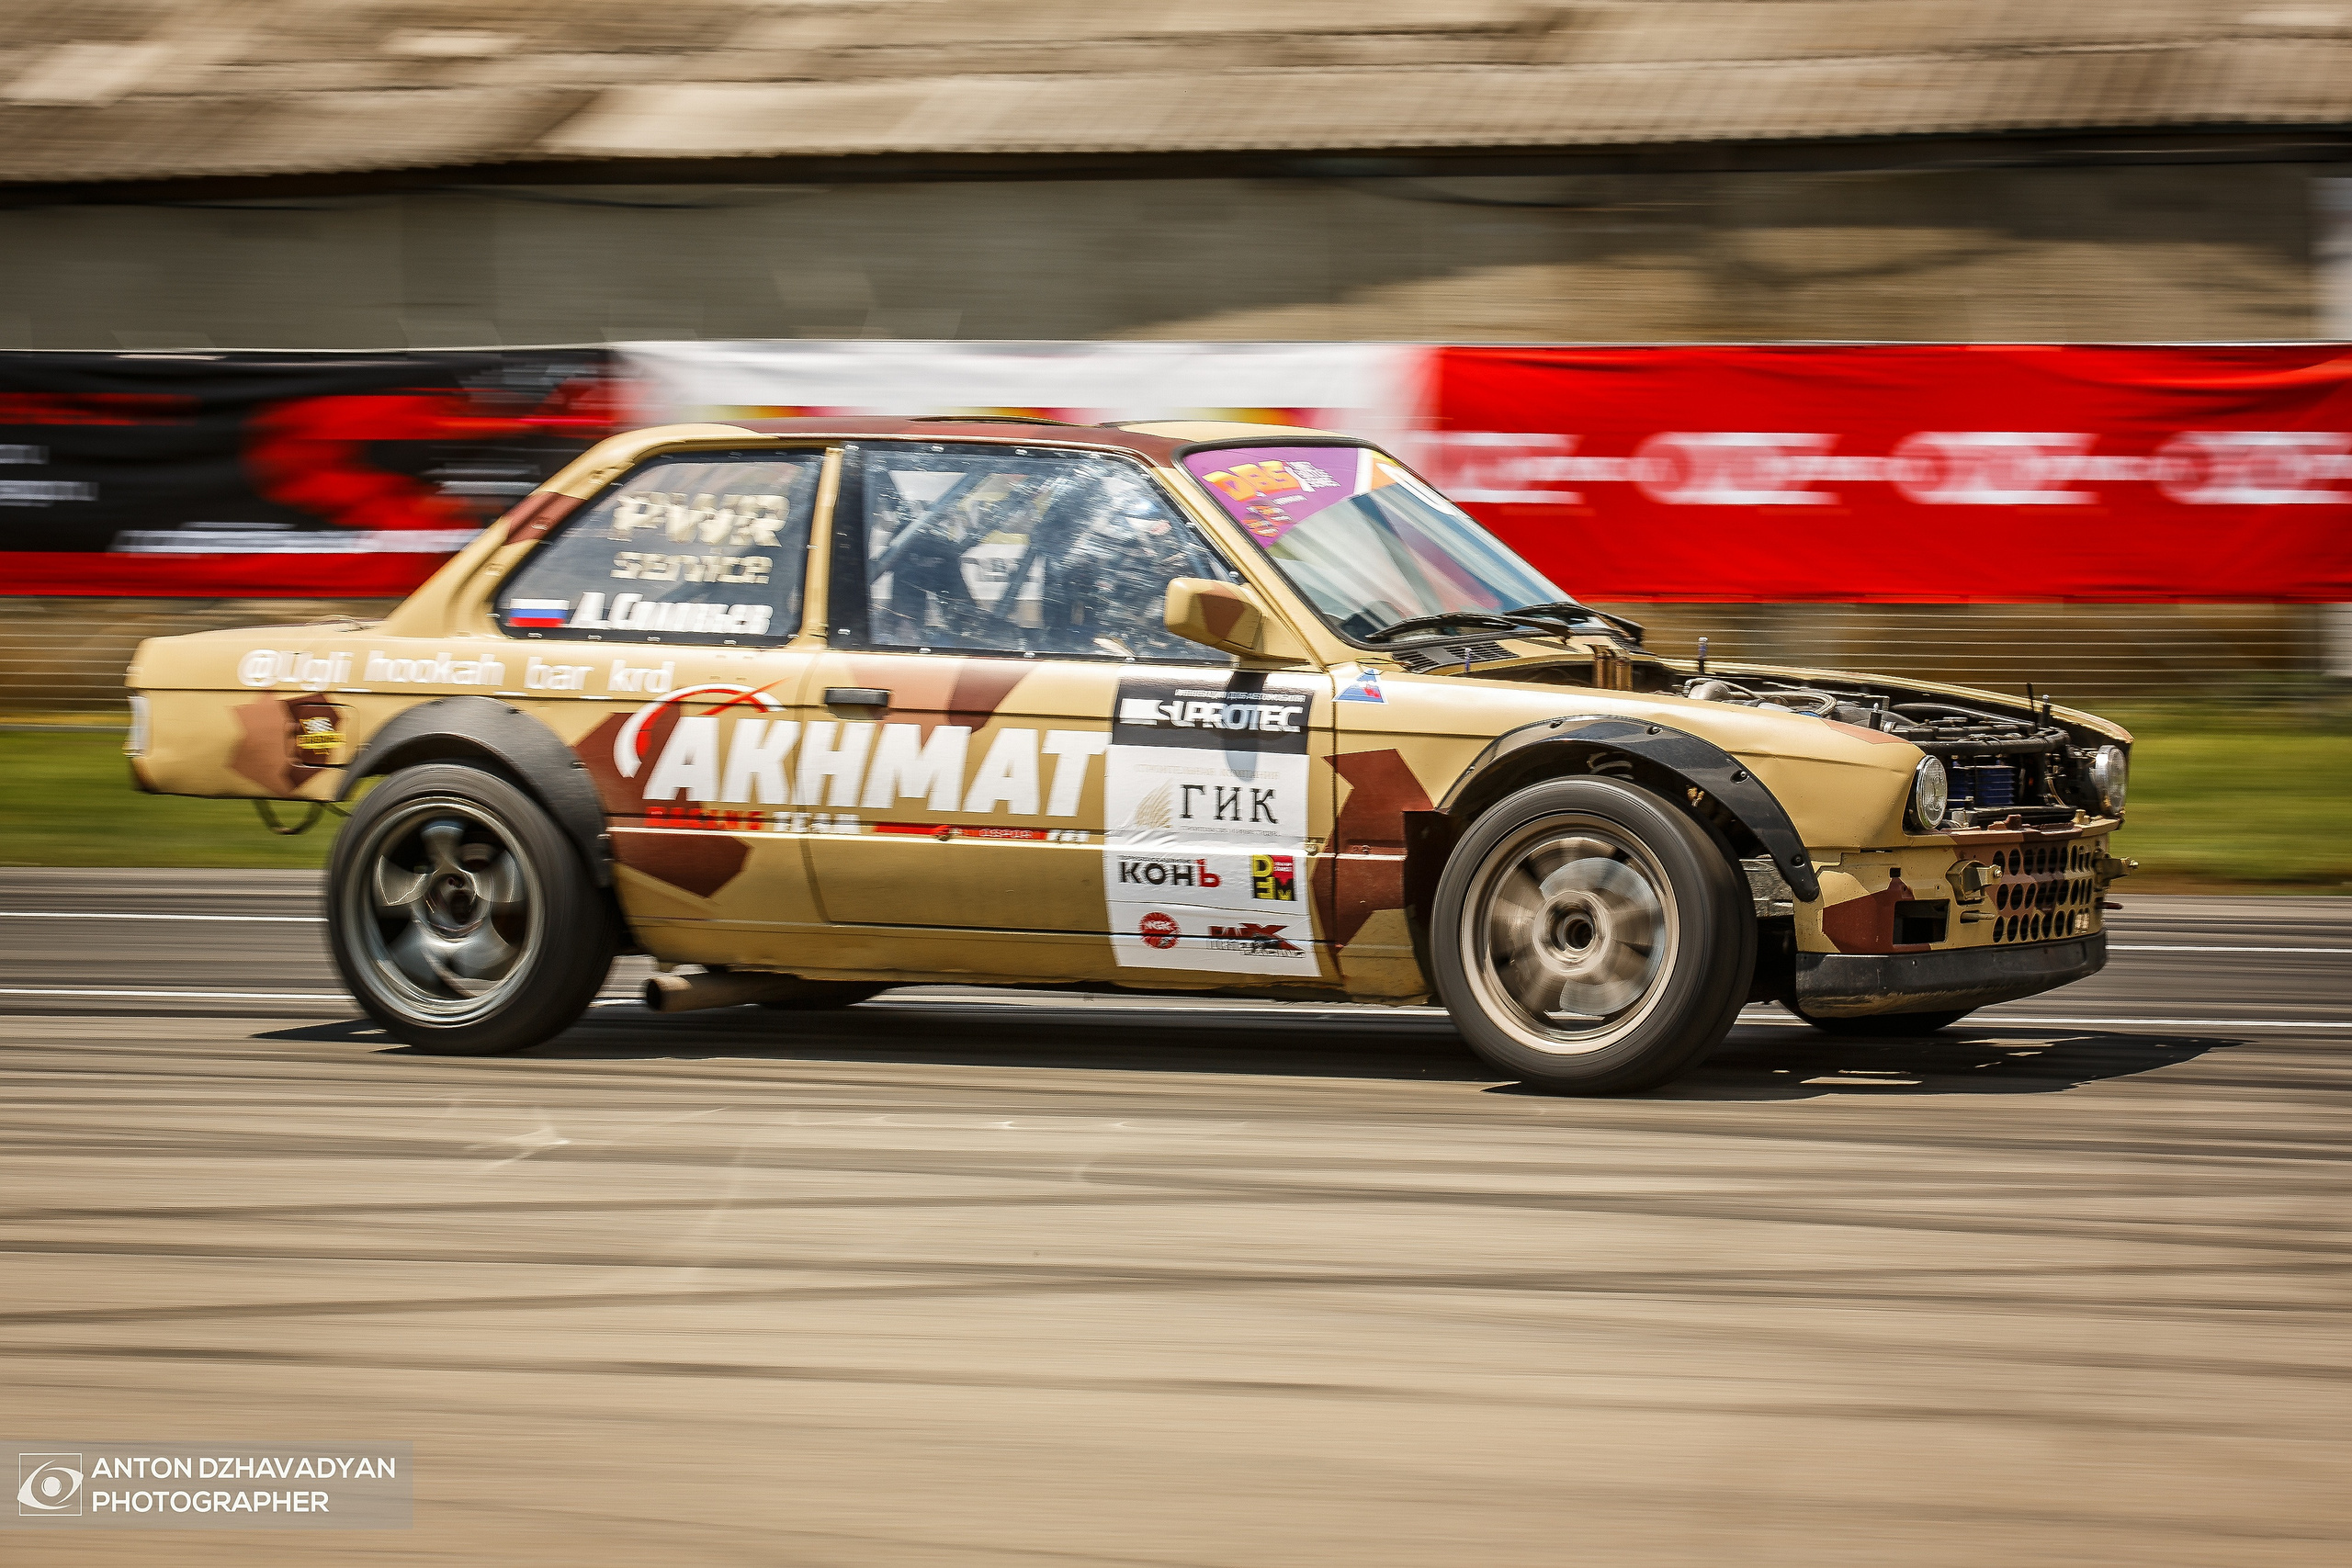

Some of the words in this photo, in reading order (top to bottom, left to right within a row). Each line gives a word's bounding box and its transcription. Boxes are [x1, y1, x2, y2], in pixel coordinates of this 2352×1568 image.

[364, 650, 506, 687] hookah
[524, 656, 595, 691] bar
[607, 660, 676, 694] krd
[642, 716, 1114, 818] AKHMAT
[1179, 784, 1281, 825] ГИК
[1118, 858, 1223, 888] КОНЬ
